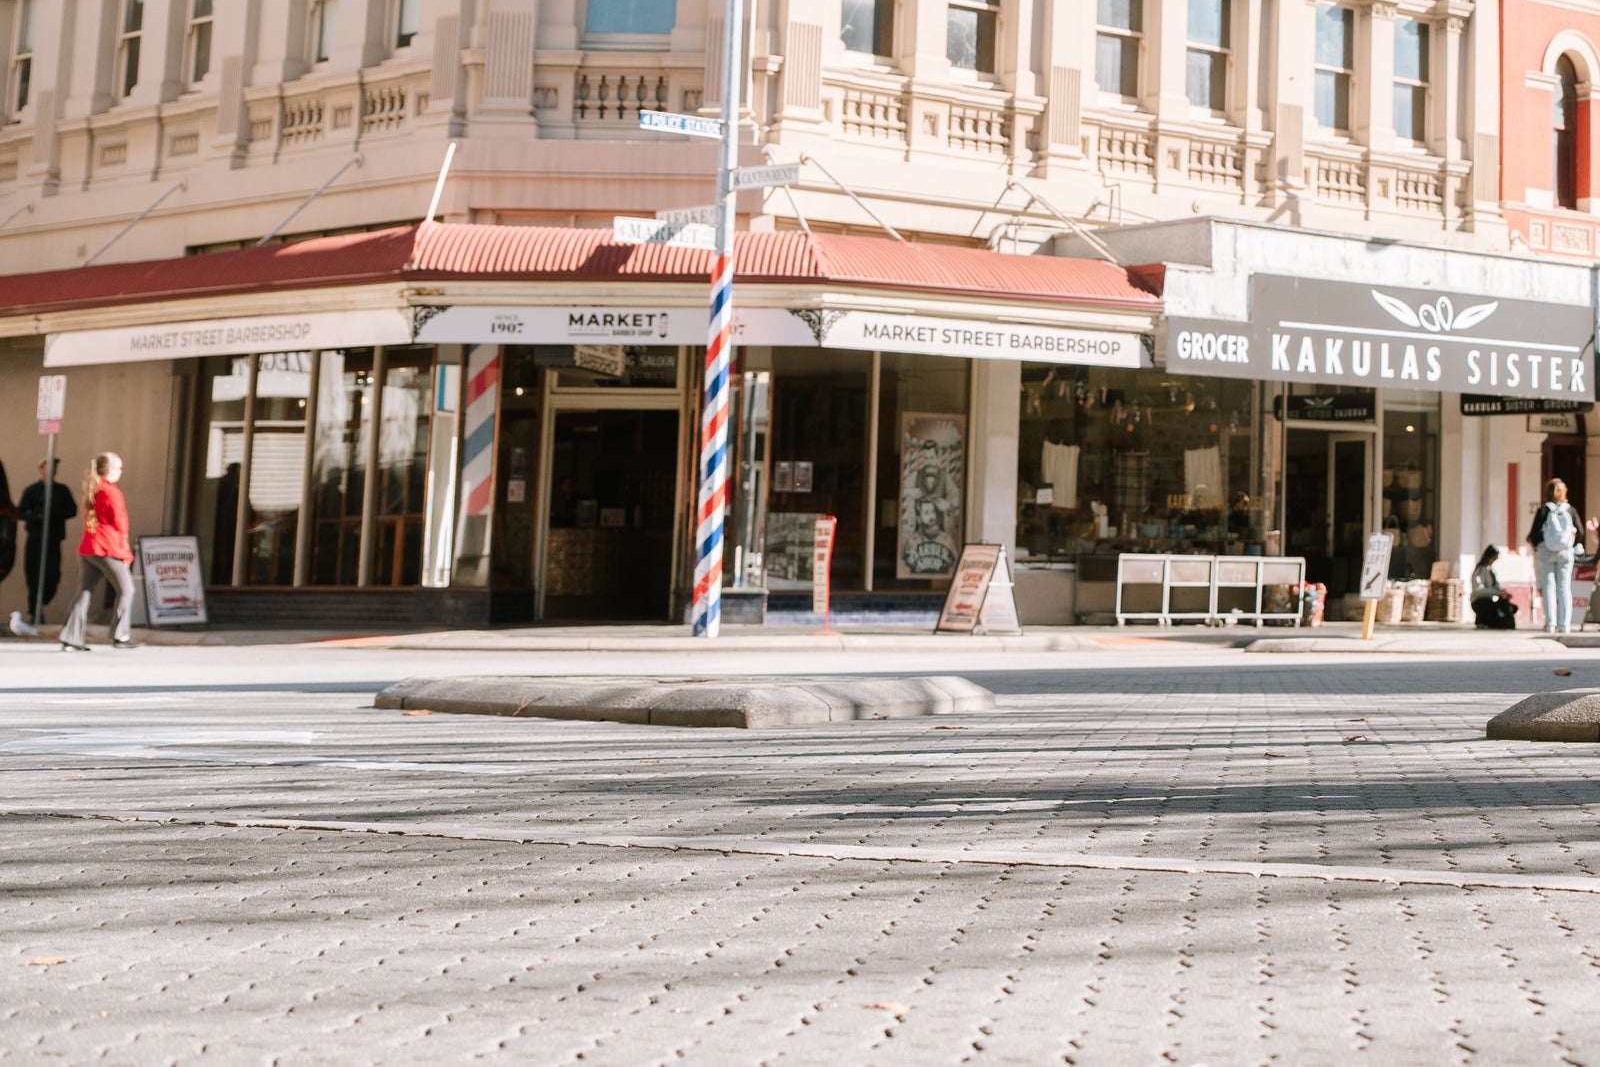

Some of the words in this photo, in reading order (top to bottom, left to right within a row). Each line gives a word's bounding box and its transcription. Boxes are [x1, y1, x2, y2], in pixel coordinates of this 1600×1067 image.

[651, 114, 682, 128] POLICE
[628, 222, 699, 244] MARKET
[569, 313, 657, 327] MARKET
[491, 322, 524, 334] 1907
[130, 332, 178, 351] MARKET
[180, 328, 222, 348] STREET
[226, 323, 311, 345] BARBERSHOP
[863, 323, 938, 343] MARKET
[942, 329, 1005, 347] STREET
[1010, 334, 1121, 356] BARBERSHOP
[1177, 330, 1249, 364] GROCER
[1272, 334, 1442, 382] KAKULAS
[1467, 349, 1586, 393] SISTER
[1464, 401, 1501, 412] KAKULAS
[145, 551, 194, 566] BARBERSHOP
[155, 565, 189, 576] OPEN
[963, 572, 983, 582] OPEN
